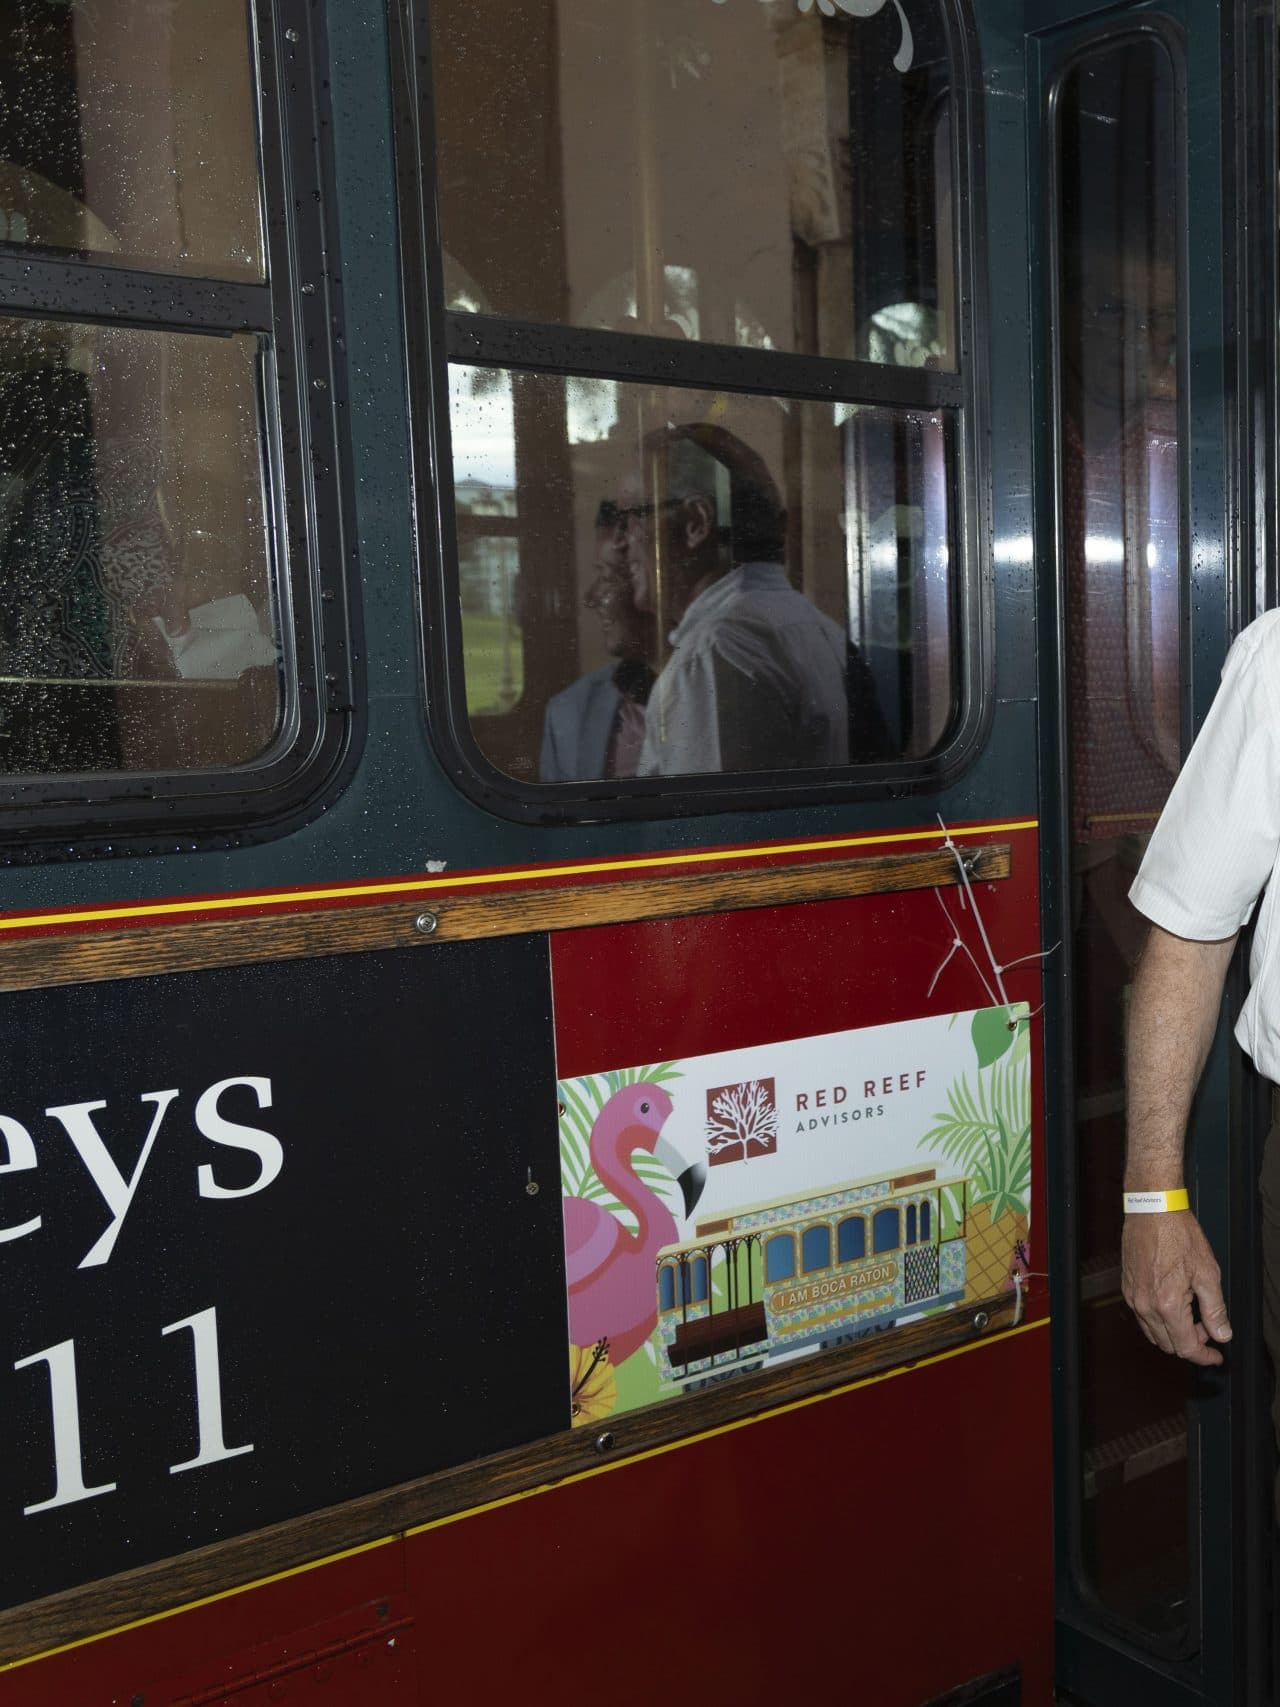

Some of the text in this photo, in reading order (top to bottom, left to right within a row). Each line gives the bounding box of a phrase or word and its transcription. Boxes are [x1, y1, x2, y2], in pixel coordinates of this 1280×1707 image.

[796, 1070, 926, 1112] RED REEF
[796, 1105, 884, 1133] ADVISORS
[780, 1266, 890, 1307] I AM BOCA RATON
